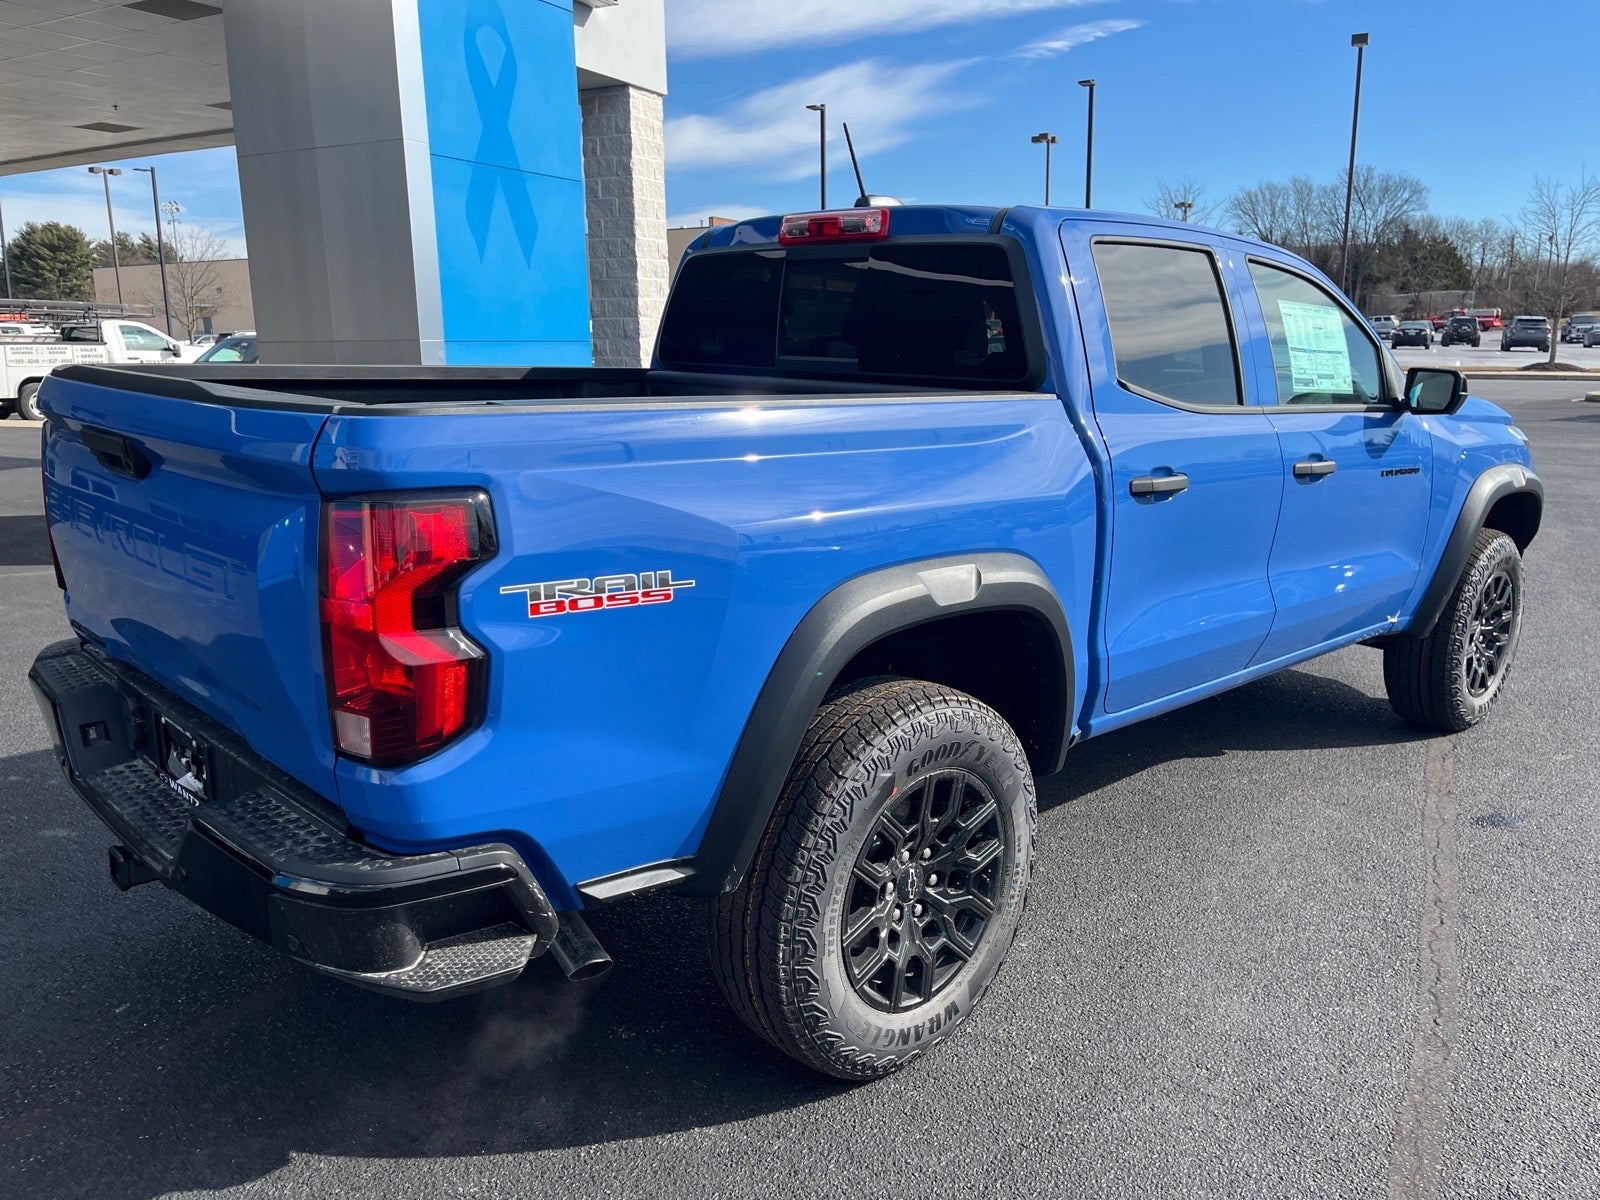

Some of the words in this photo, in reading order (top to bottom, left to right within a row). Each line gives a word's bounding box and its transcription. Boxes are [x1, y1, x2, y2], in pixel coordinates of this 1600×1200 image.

[46, 487, 247, 601] CHEVROLET
[500, 570, 696, 602] TRAIL
[528, 588, 674, 618] BOSS
[846, 999, 960, 1048] WRANGLER
